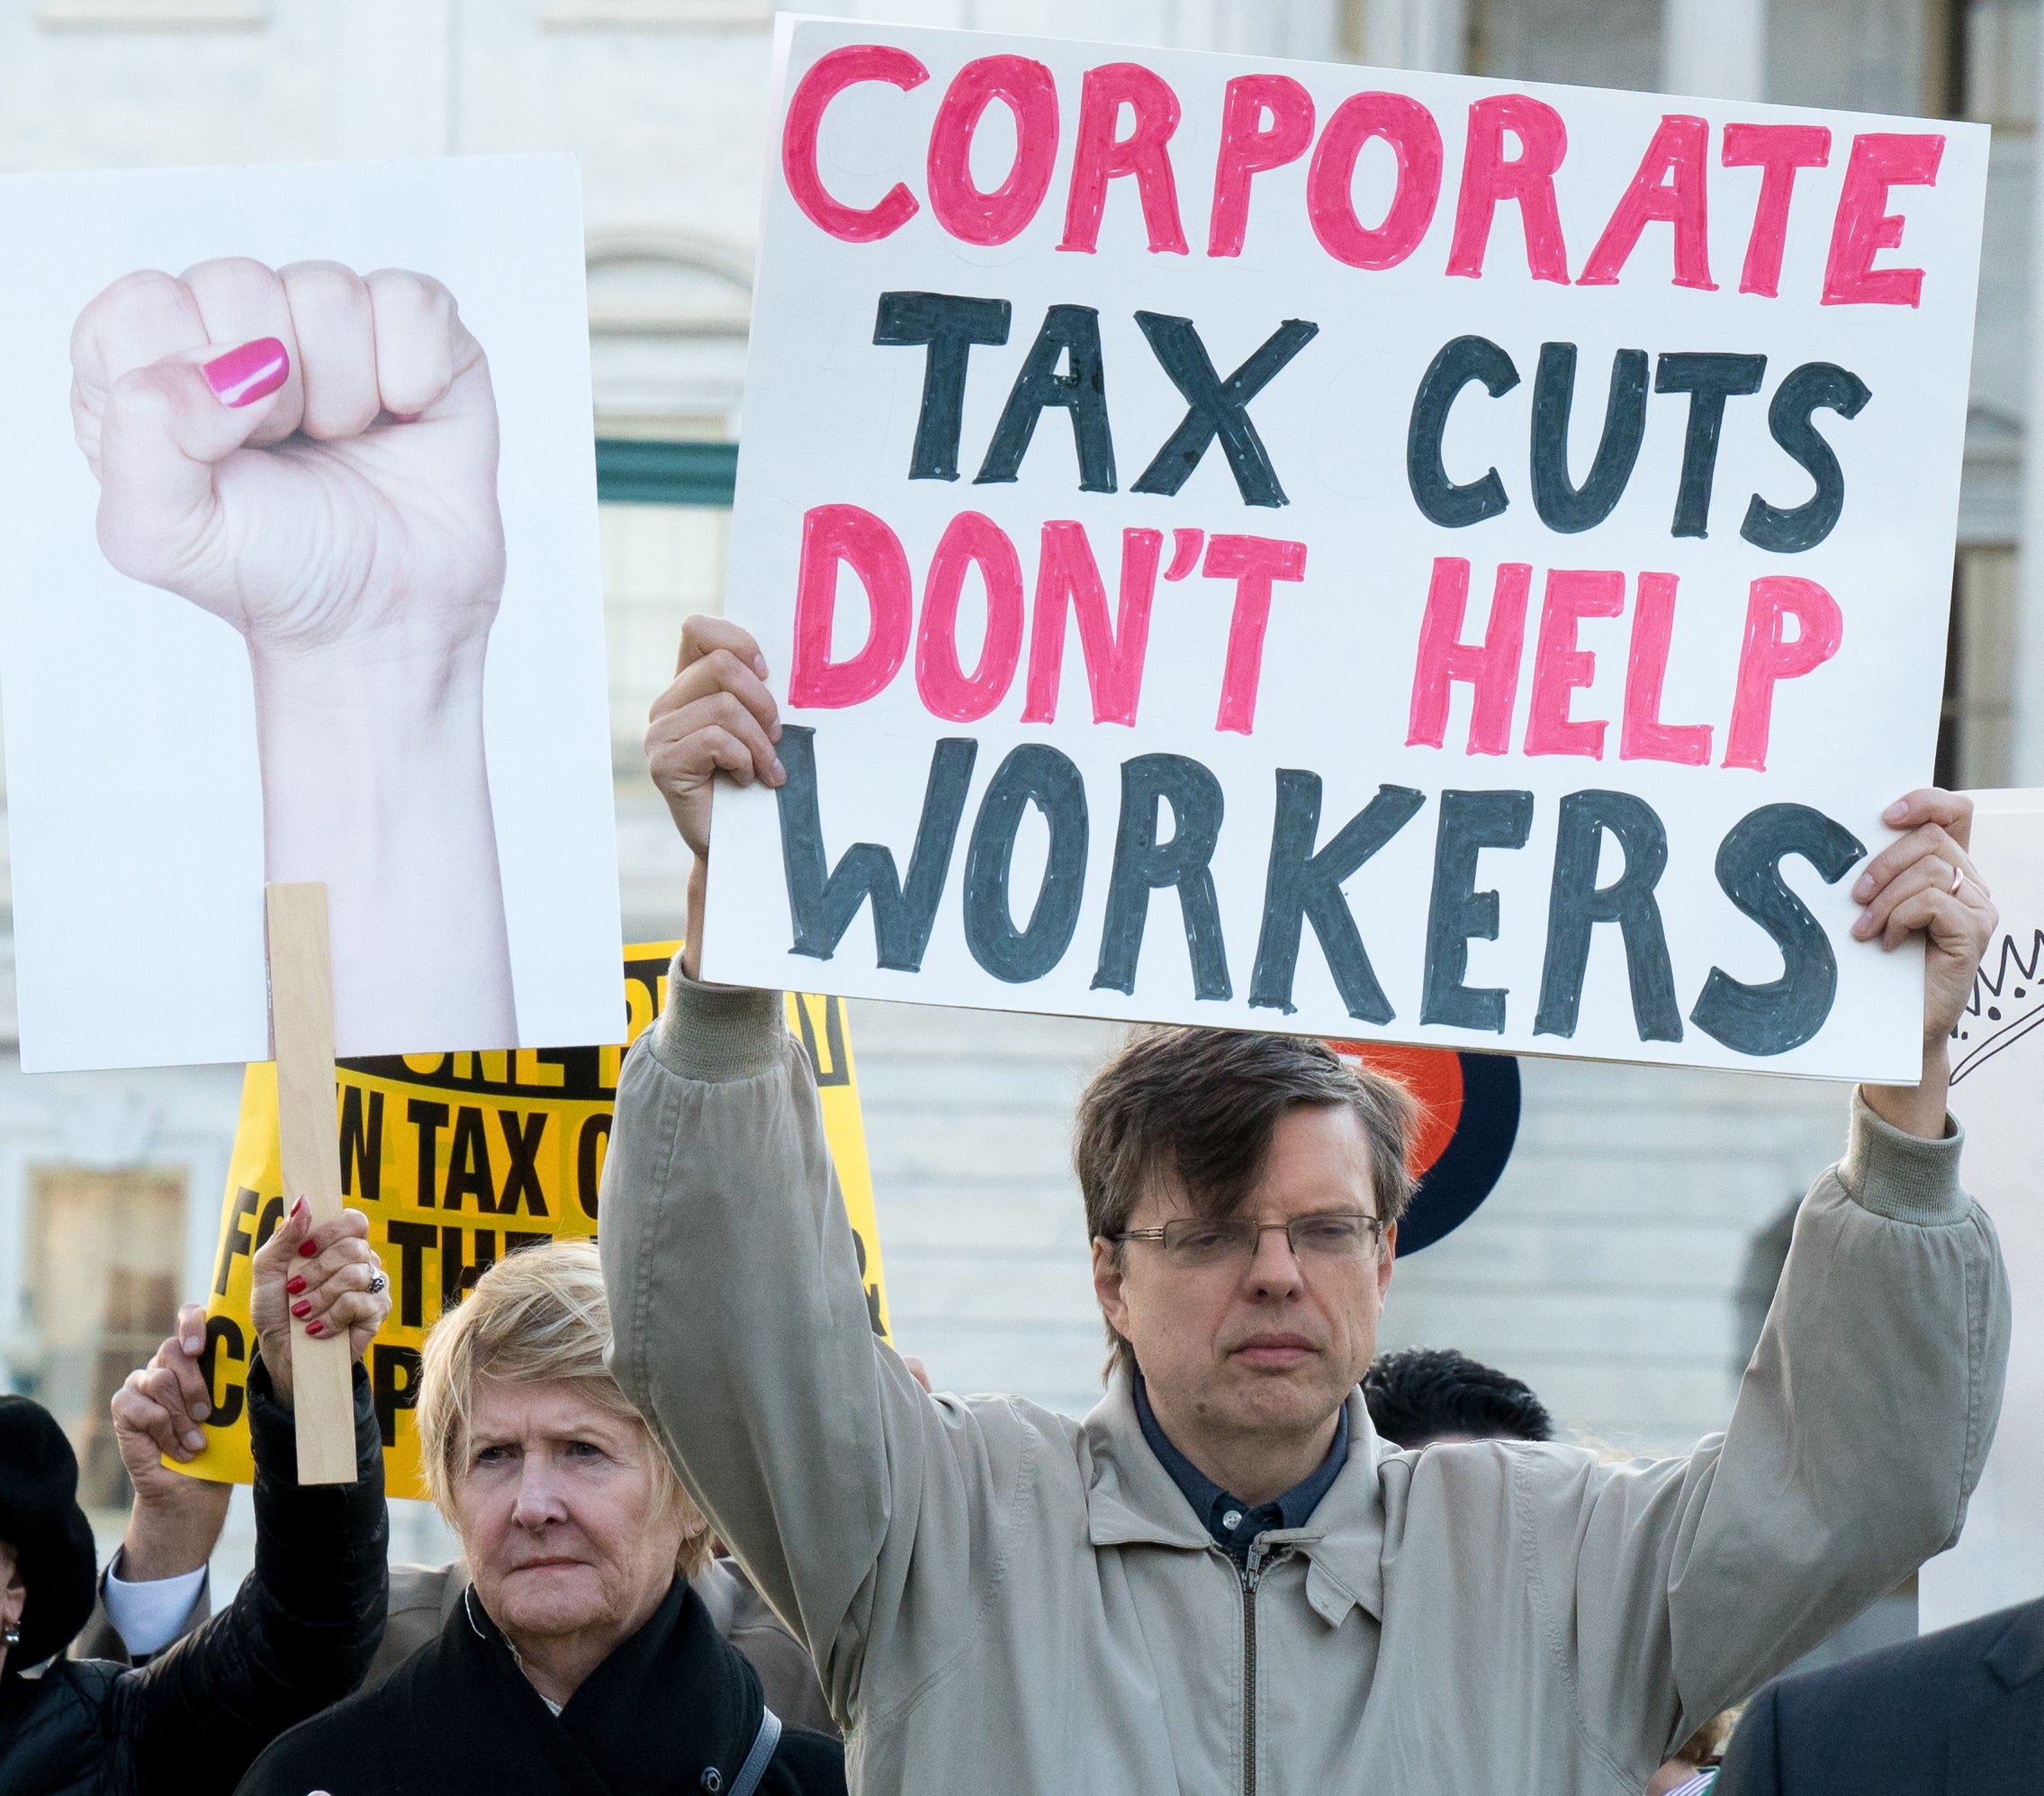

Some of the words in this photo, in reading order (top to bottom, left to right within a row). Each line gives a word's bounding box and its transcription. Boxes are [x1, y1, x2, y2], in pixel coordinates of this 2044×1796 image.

[782, 45, 1945, 308] CORPORATE
[873, 292, 1319, 508] TAX
[1407, 335, 1872, 553] CUTS
[788, 504, 1307, 735] DON'T
[1406, 557, 1842, 772] HELP
[779, 724, 1868, 1056] WORKERS
[337, 1082, 384, 1202] N
[408, 1098, 549, 1216] TAX
[388, 1220, 552, 1327] TH
